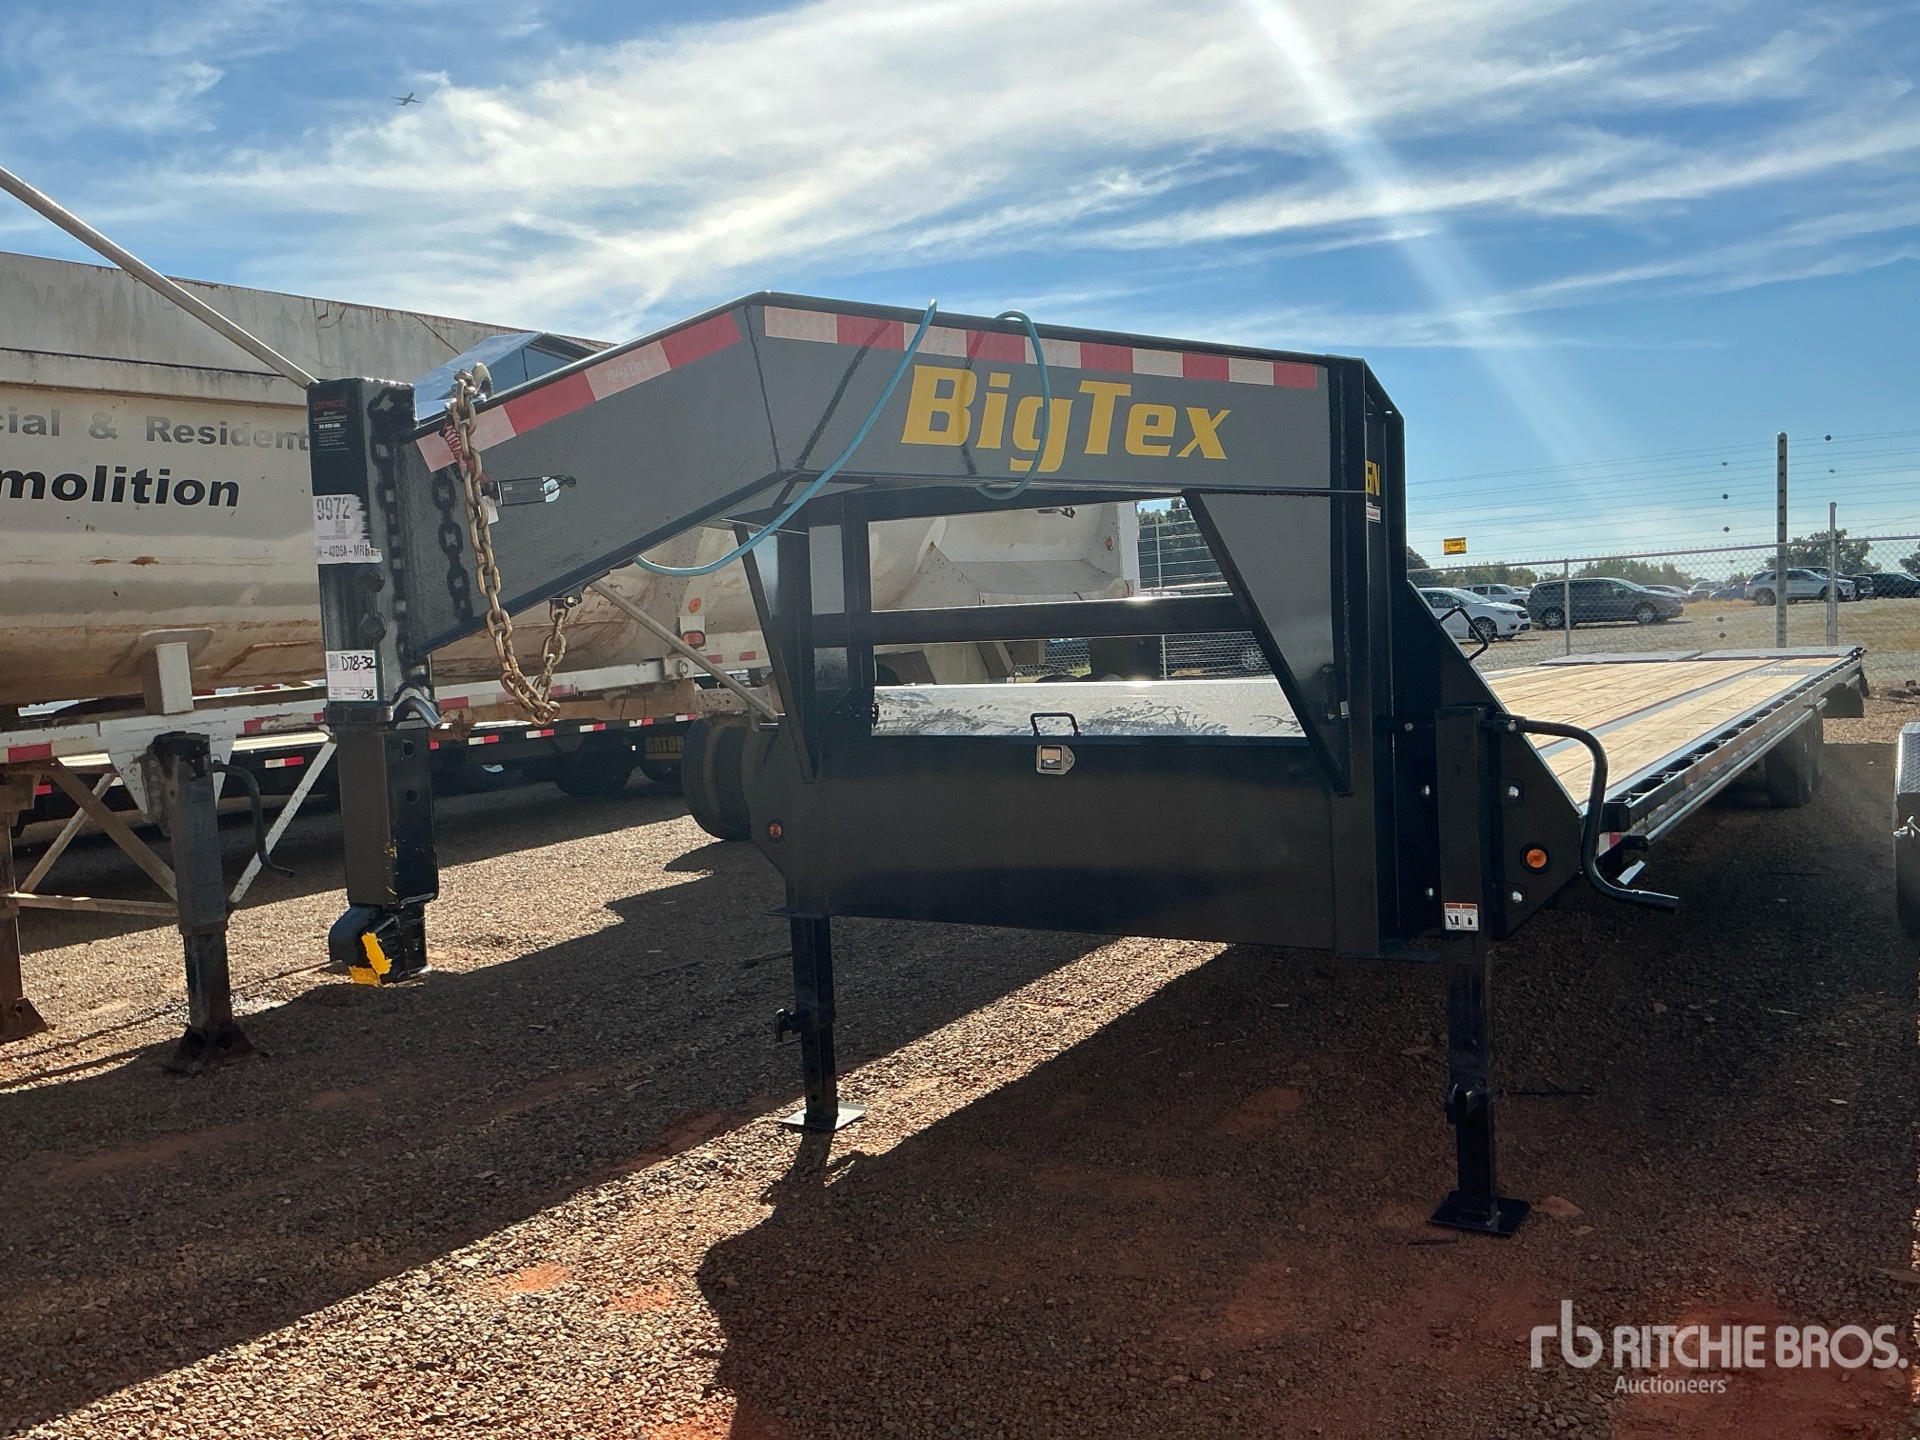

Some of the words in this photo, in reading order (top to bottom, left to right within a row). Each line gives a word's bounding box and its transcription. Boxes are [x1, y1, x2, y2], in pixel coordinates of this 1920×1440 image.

[88, 411, 118, 440] &
[901, 365, 1232, 473] BigTex
[0, 465, 240, 507] molition
